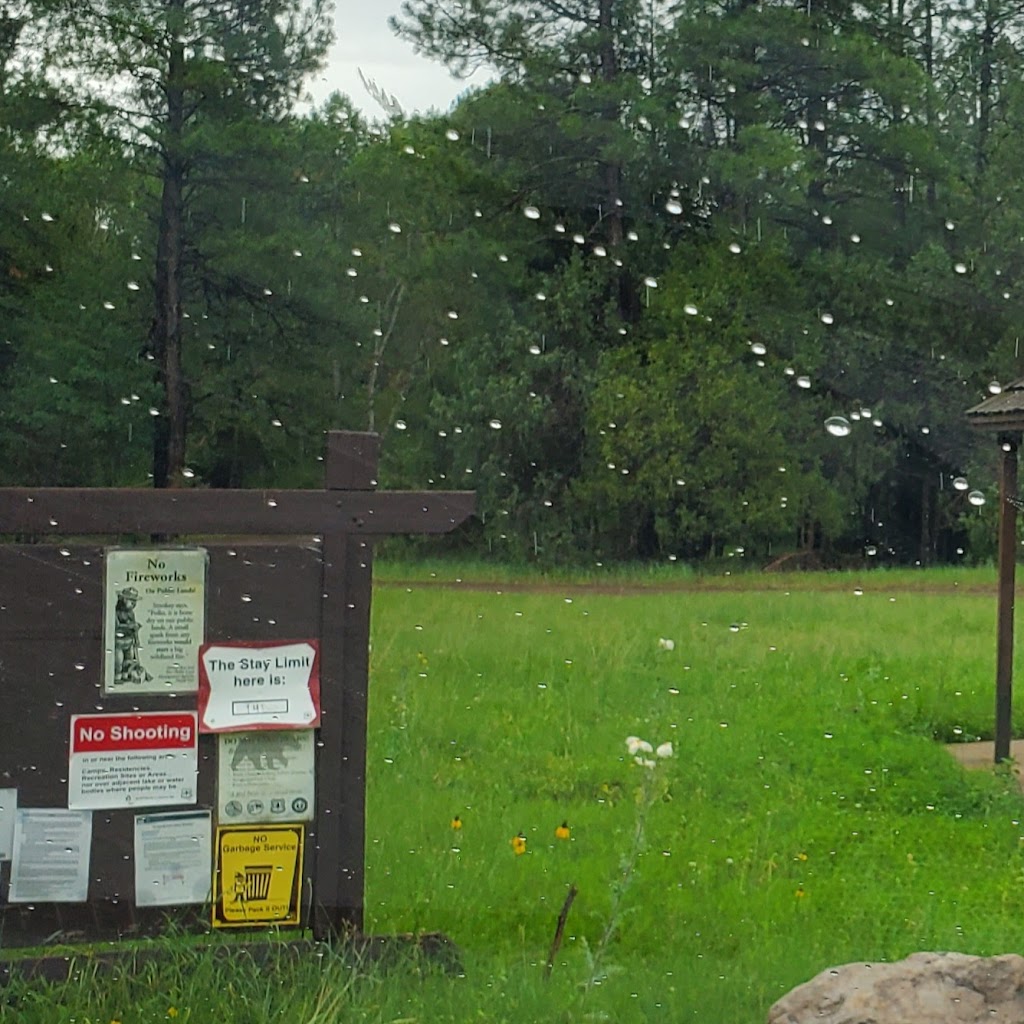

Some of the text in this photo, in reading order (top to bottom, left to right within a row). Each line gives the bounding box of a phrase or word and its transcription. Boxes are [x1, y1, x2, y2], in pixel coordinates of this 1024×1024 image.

[147, 558, 166, 570] No
[126, 571, 187, 582] Fireworks
[208, 655, 310, 672] The Stay Limit
[233, 673, 286, 688] here is:
[79, 723, 191, 743] No Shooting
[127, 754, 157, 762] following
[112, 779, 140, 787] adjacent
[128, 785, 151, 793] people
[253, 835, 268, 843] NO
[222, 843, 296, 853] Garbage Service
